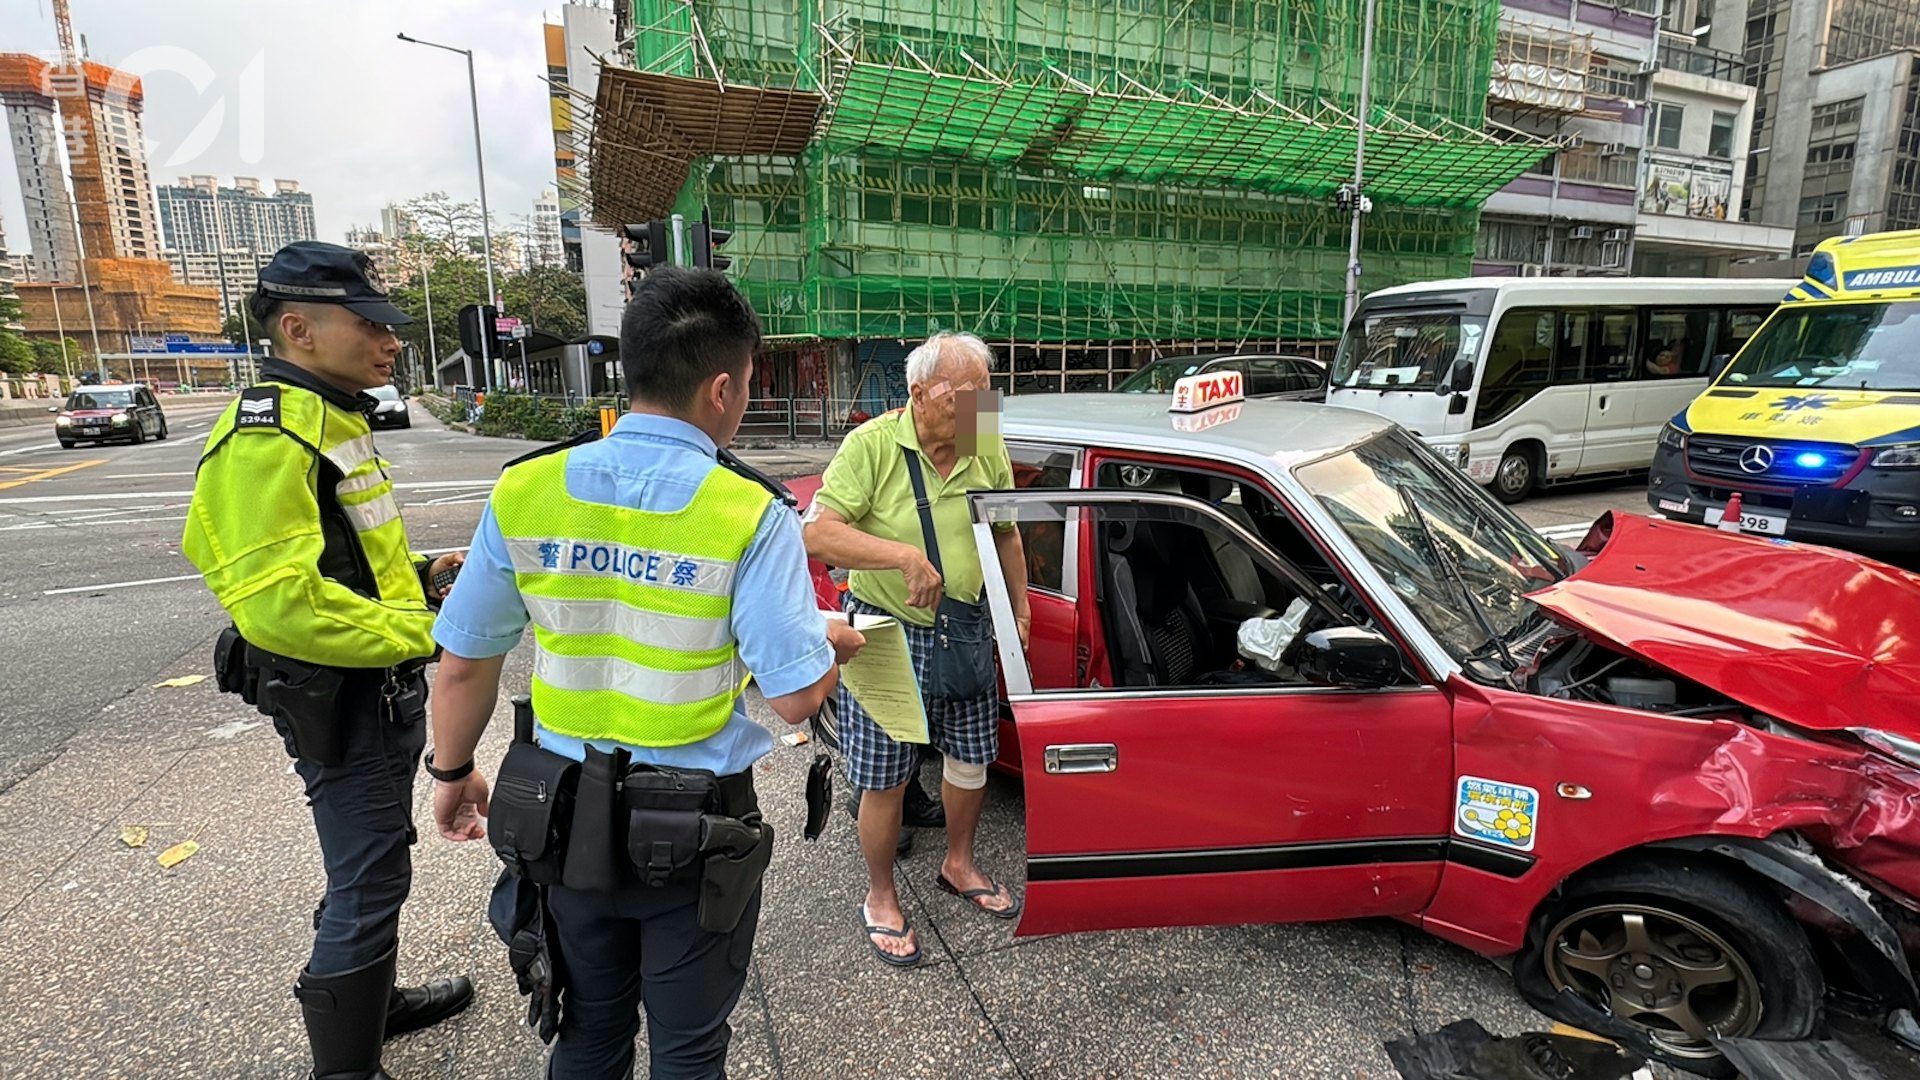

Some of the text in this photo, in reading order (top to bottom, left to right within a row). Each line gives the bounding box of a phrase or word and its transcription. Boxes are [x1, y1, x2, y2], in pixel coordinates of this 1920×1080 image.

[1198, 376, 1239, 403] TAXI
[240, 415, 275, 424] 52944
[538, 543, 698, 586] 警 POLICE 察
